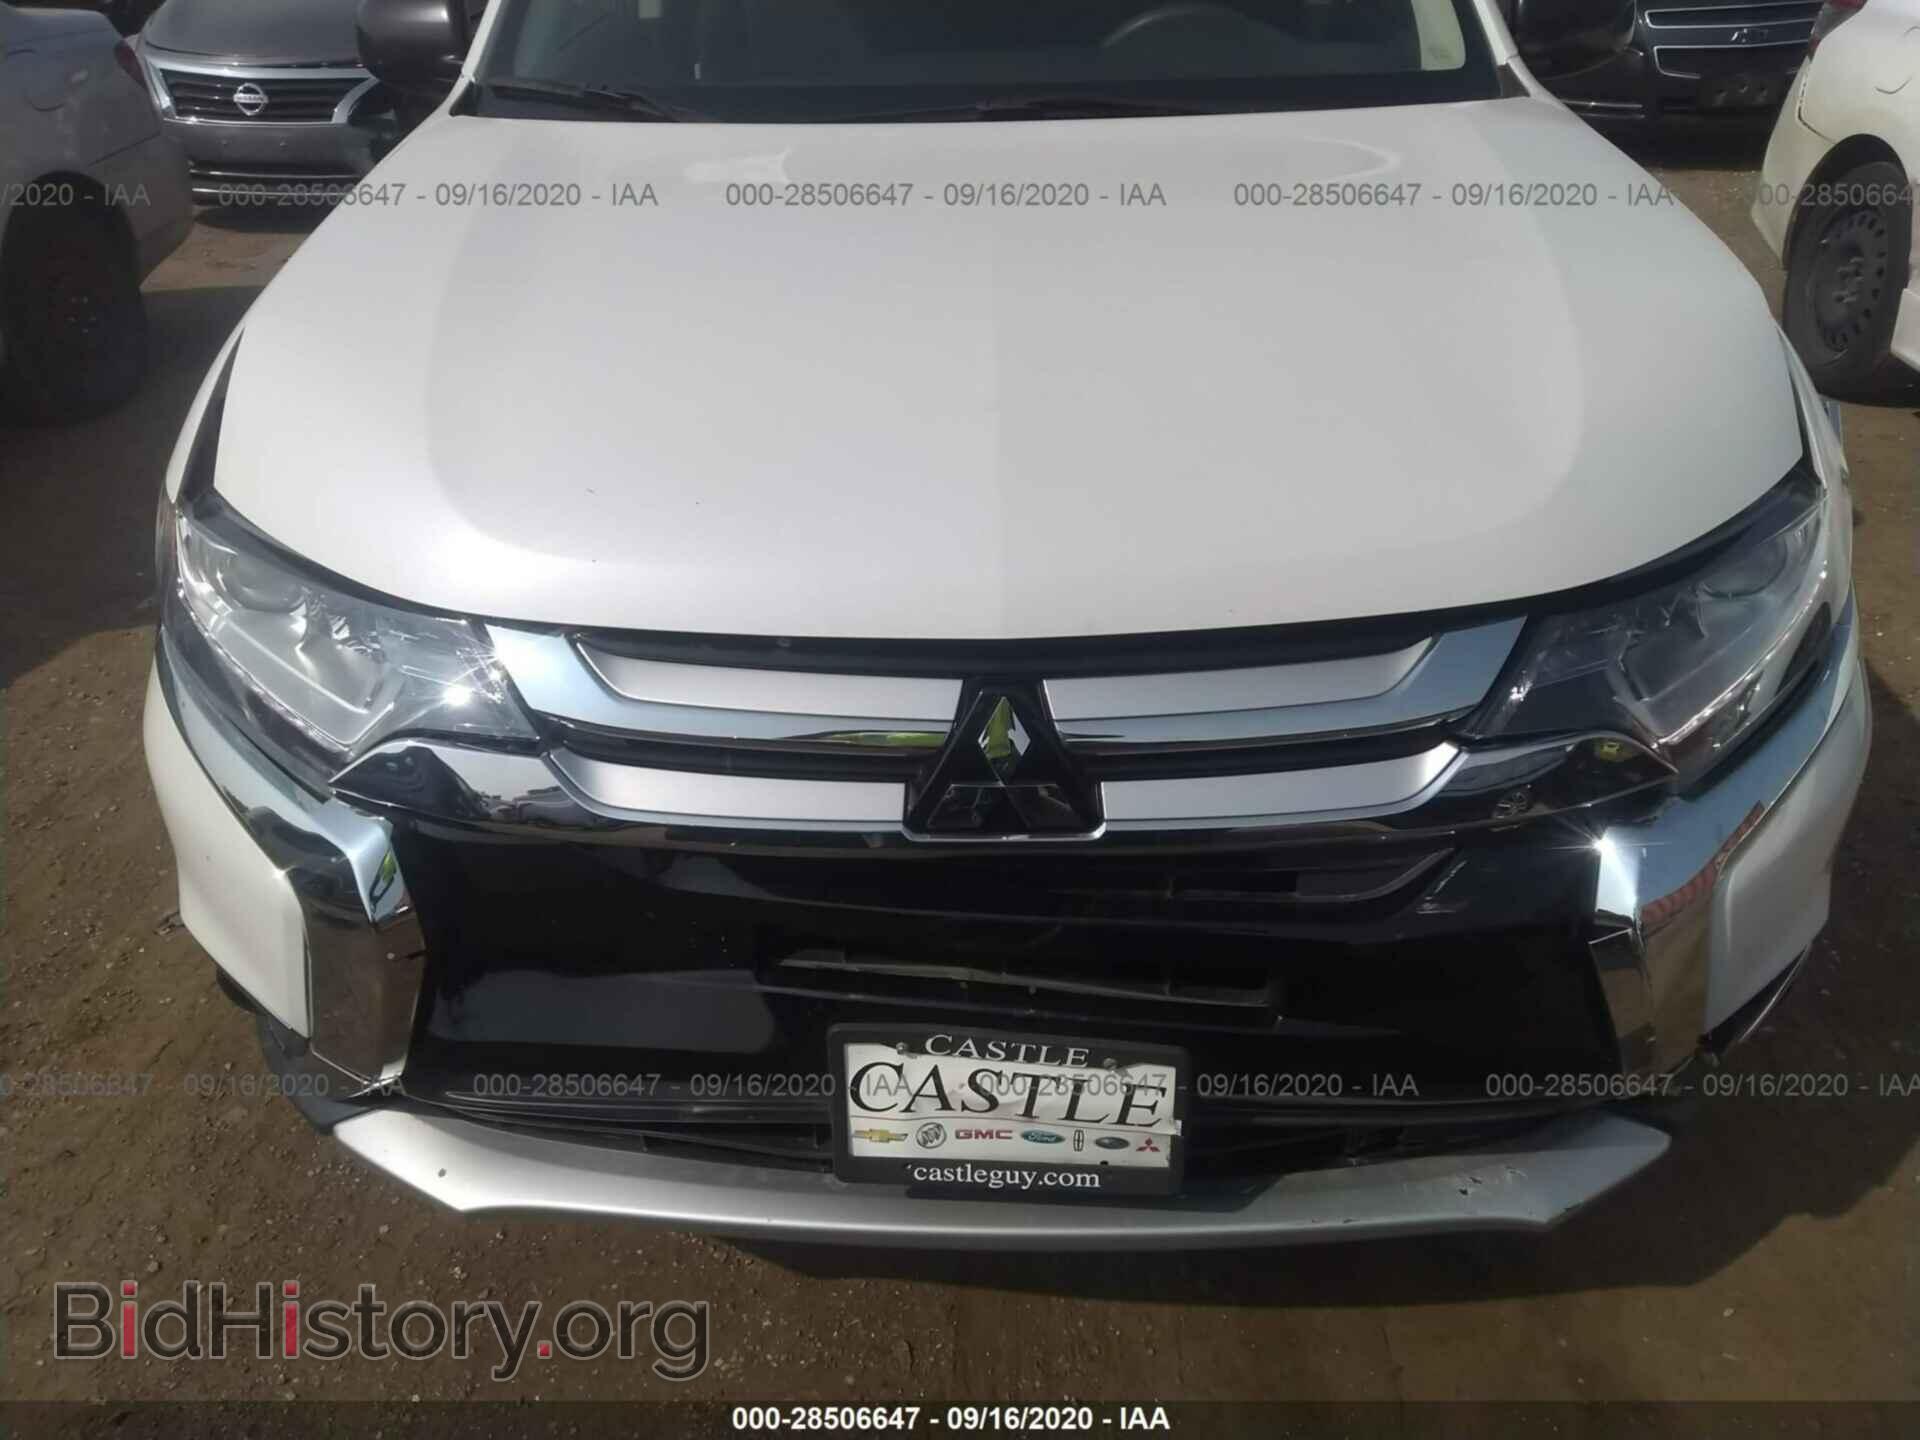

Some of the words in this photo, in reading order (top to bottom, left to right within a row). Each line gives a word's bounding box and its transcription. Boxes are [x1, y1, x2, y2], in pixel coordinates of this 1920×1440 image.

[925, 1034, 1091, 1069] CASTLE
[850, 1061, 1167, 1128] CASTLE
[955, 1128, 1013, 1140] GMC
[913, 1163, 1101, 1190] castleguy.com
